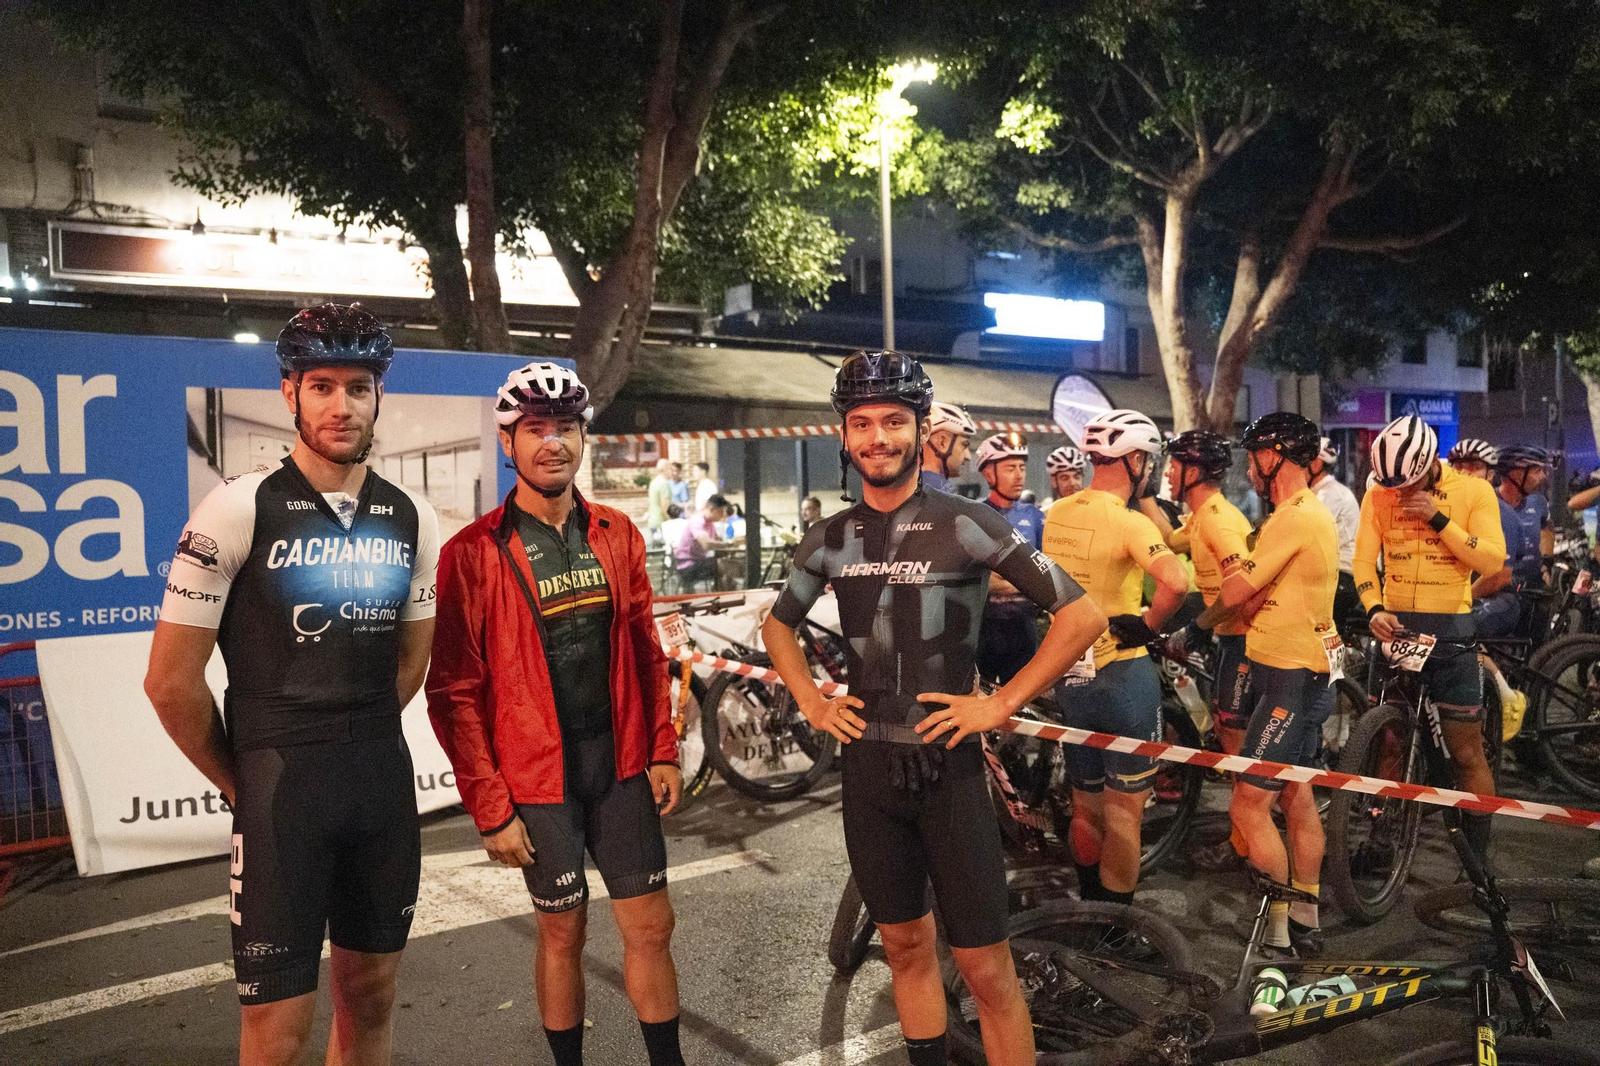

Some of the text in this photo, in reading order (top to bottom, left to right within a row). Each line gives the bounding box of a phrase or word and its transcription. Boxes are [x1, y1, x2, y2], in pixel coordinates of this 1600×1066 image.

[1419, 401, 1453, 413] GOMAR
[286, 501, 318, 511] GOBIK
[369, 505, 394, 516] BH
[896, 523, 933, 532] KAKUL
[267, 537, 411, 570] CACHANBIKE
[841, 561, 931, 577] HARMAN
[333, 570, 374, 588] TEAM
[888, 575, 926, 584] CLUB
[339, 602, 397, 620] Chisma
[1390, 640, 1428, 659] 6844
[1231, 672, 1246, 710] LevelPRO
[1274, 712, 1296, 744] BIKE TEAM
[1252, 717, 1280, 760] LevelPRO
[230, 833, 244, 927] BH
[243, 946, 289, 957] SERRANA
[1302, 964, 1421, 977] SCOTT
[237, 982, 260, 996] BIKE
[1256, 974, 1431, 1037] SCOTT
